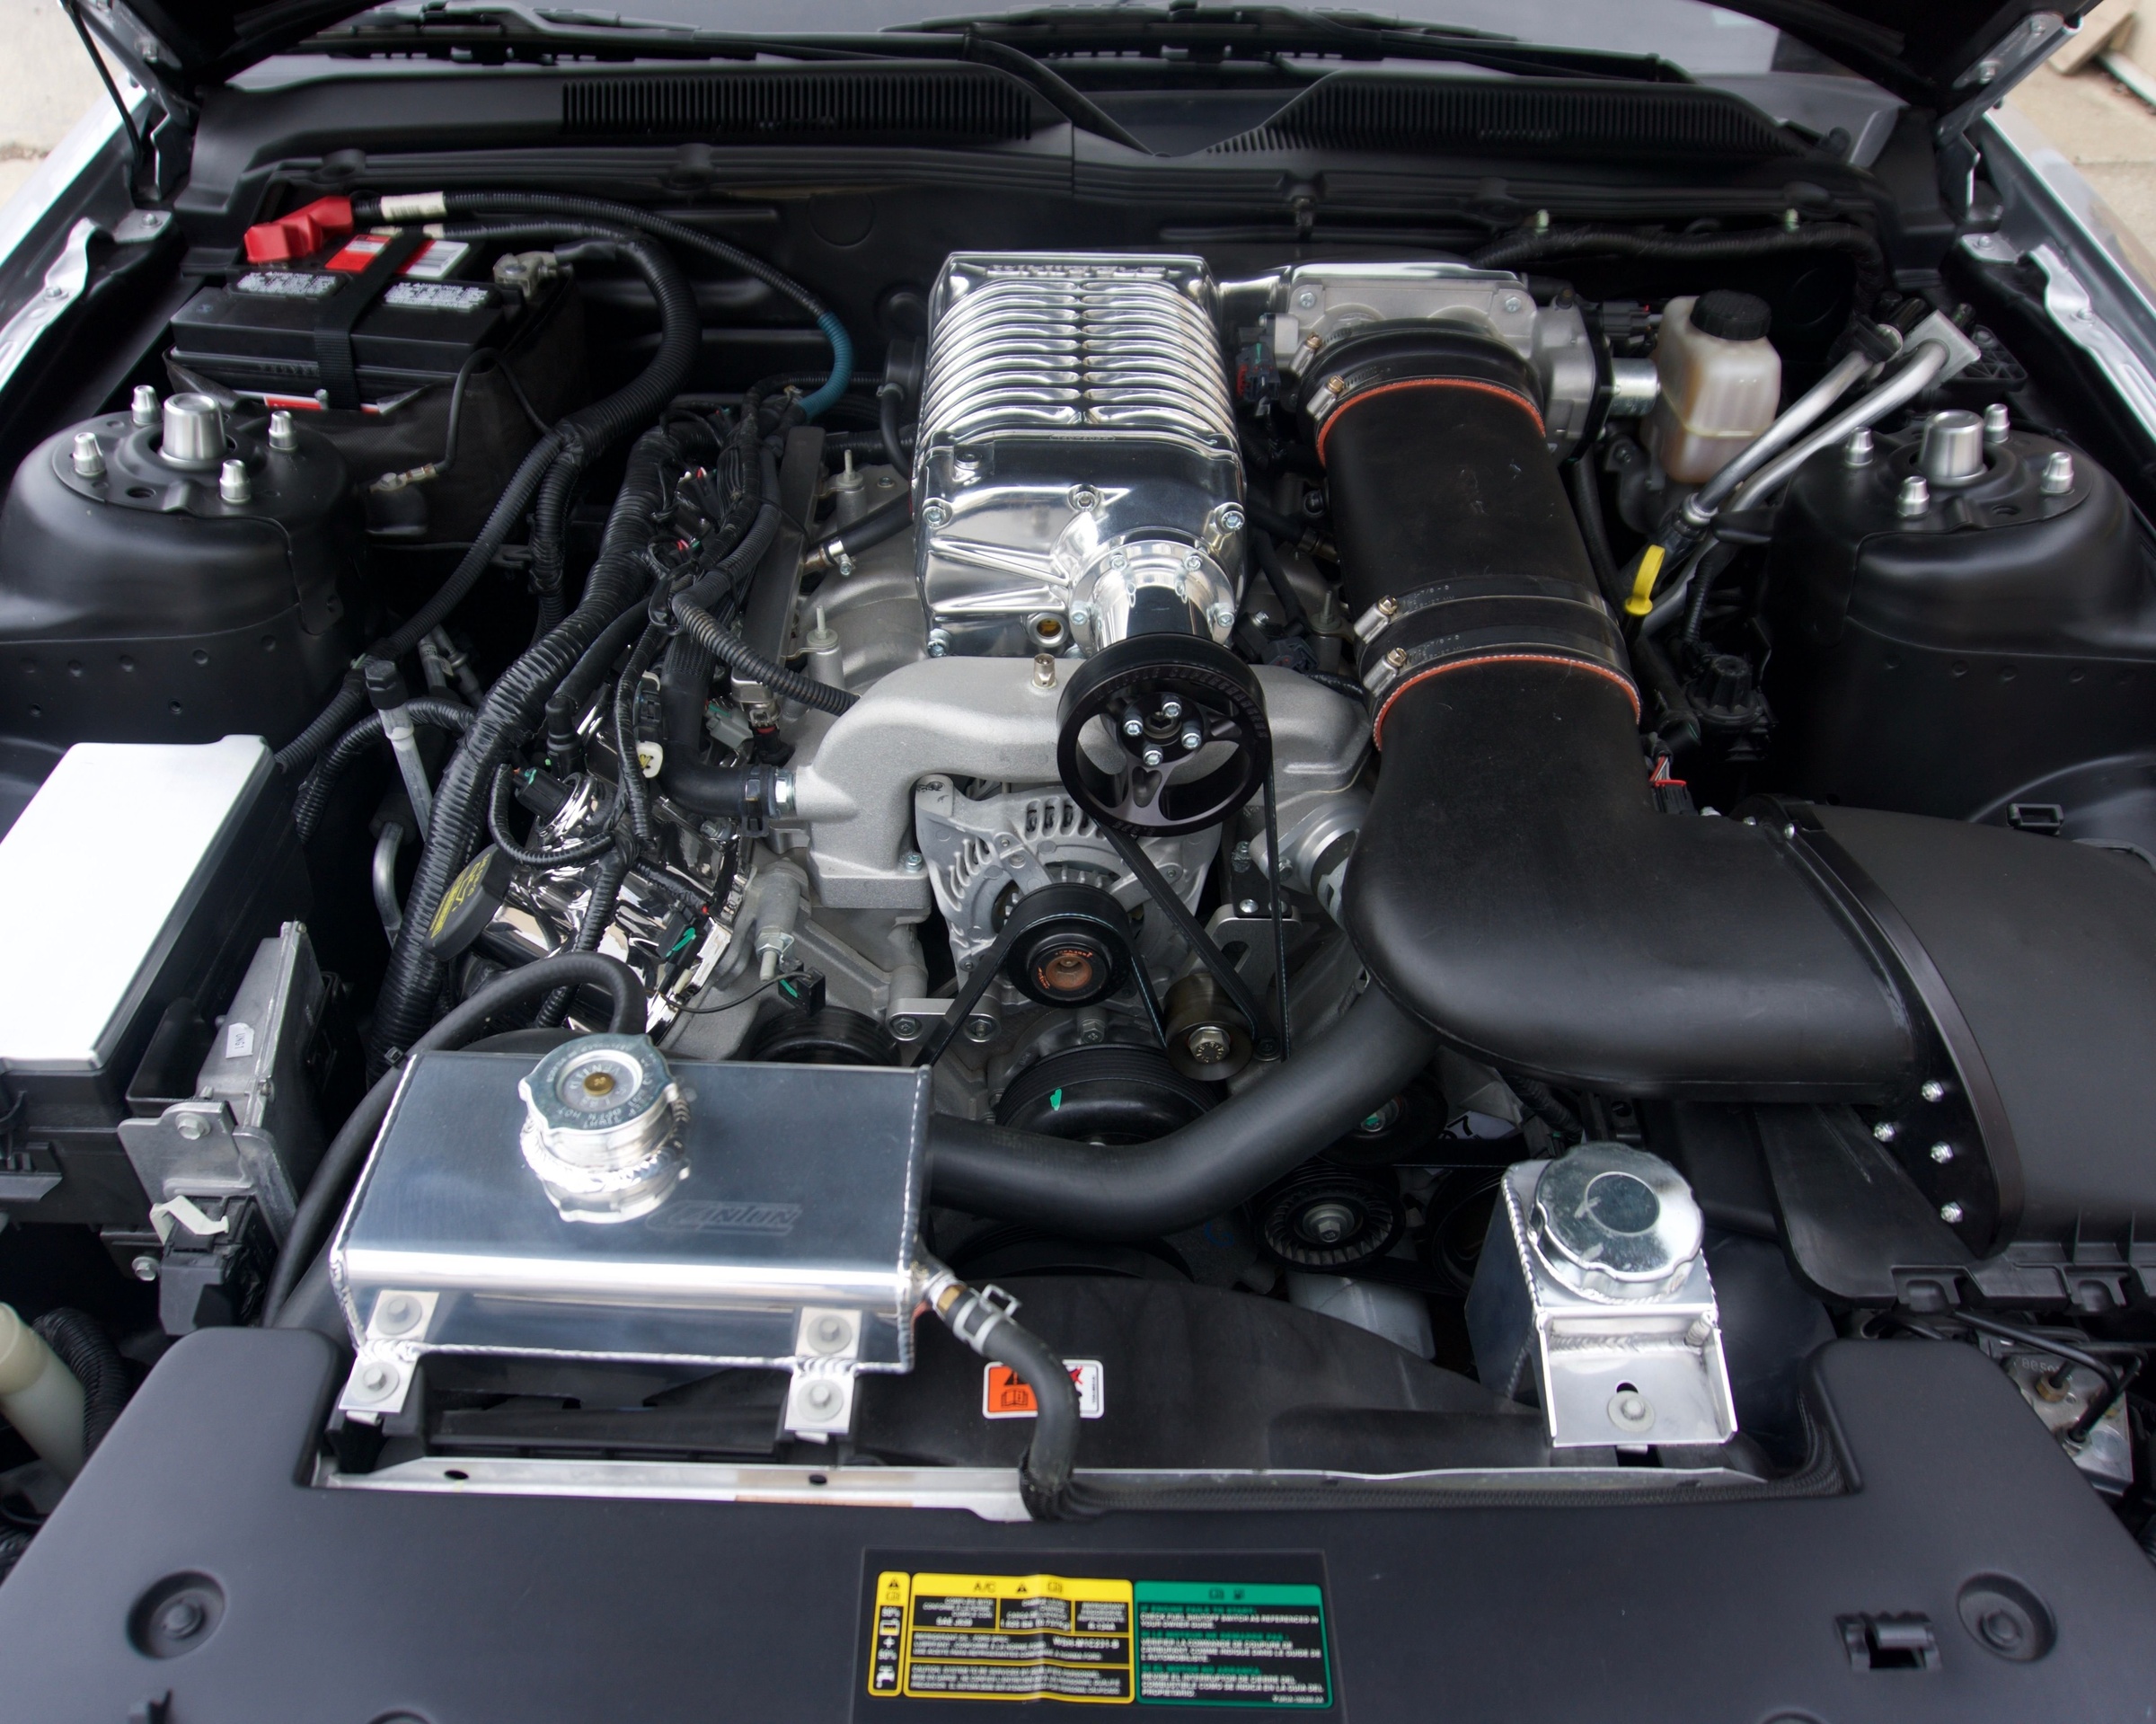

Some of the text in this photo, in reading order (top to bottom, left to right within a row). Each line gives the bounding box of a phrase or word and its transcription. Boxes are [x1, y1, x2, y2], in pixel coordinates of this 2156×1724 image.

[973, 1581, 996, 1594] A/C
[880, 1606, 901, 1618] 50%
[1140, 1612, 1166, 1622] CHECK
[1167, 1613, 1186, 1622] FUEL
[1186, 1613, 1220, 1623] SHUTOFF
[1220, 1613, 1250, 1623] SWITCH
[1250, 1614, 1259, 1623] AS
[1260, 1614, 1310, 1624] REFERENCED
[1162, 1621, 1189, 1629] OWNER
[1188, 1639, 1231, 1649] COMMANDE
[1232, 1640, 1242, 1649] DE
[1243, 1641, 1281, 1649] COUPURE
[1282, 1641, 1294, 1649] DE
[878, 1649, 898, 1660] 50%
[1189, 1648, 1219, 1656] COMME
[1251, 1649, 1274, 1657] DANS
[1274, 1649, 1285, 1658] LE
[1286, 1649, 1309, 1658] GUIDE
[1310, 1649, 1321, 1658] DE
[1141, 1681, 1197, 1689] COMBUSTIBLE
[1224, 1683, 1234, 1691] SE
[1263, 1684, 1275, 1692] EN
[1276, 1684, 1286, 1692] LA
[1307, 1684, 1324, 1693] DEL
